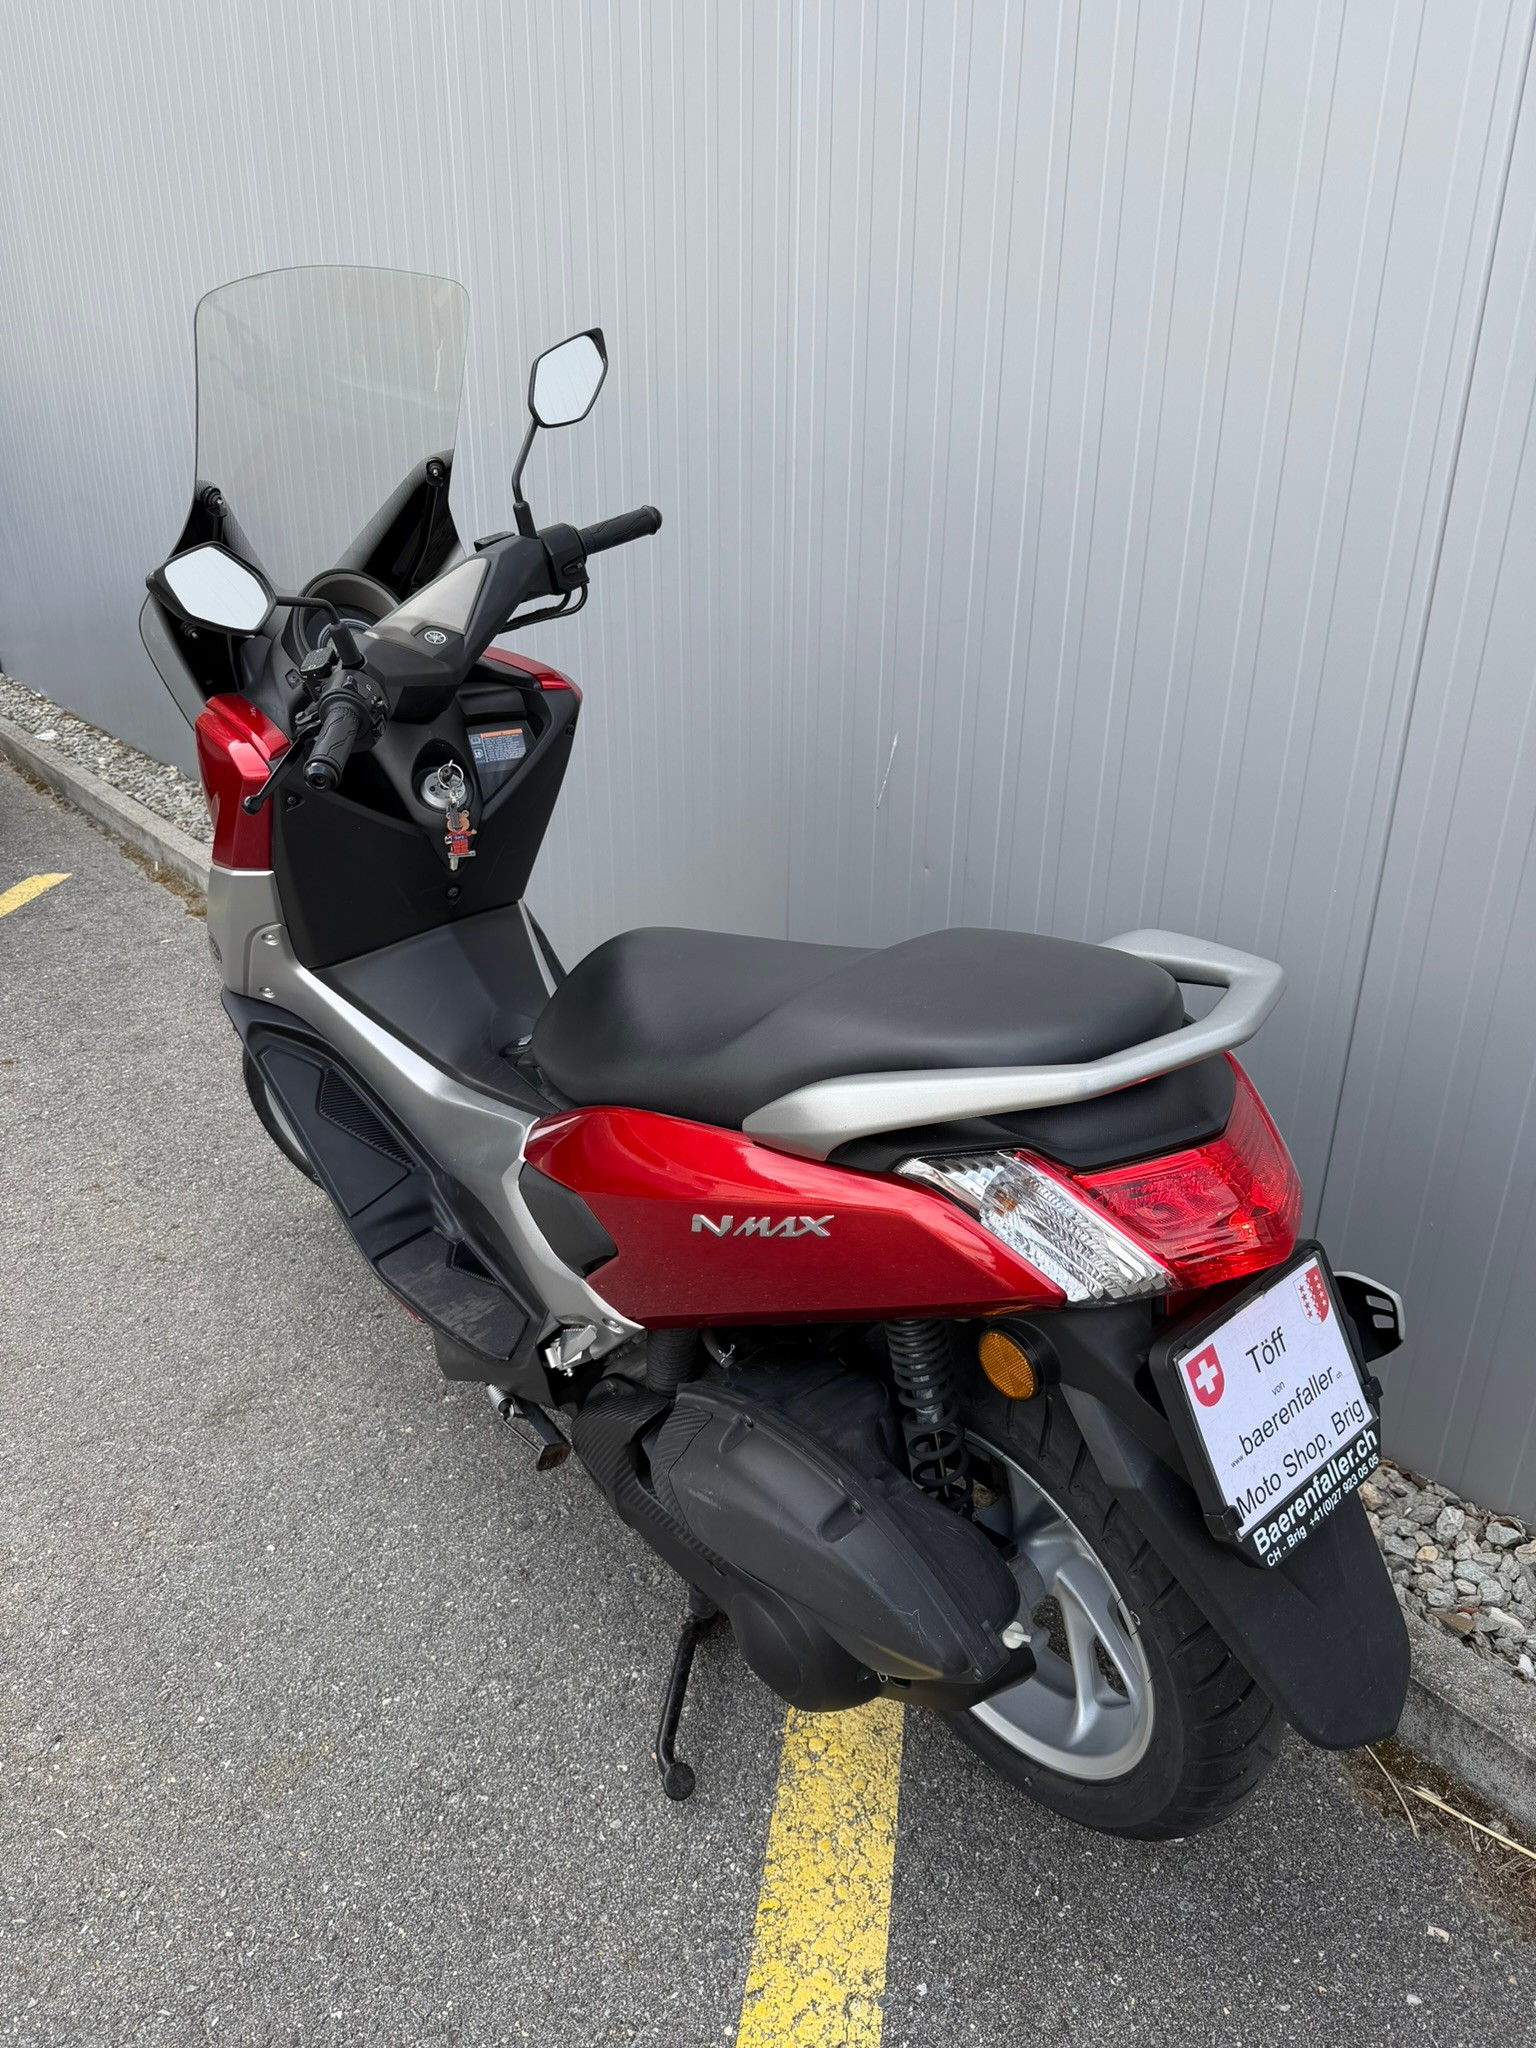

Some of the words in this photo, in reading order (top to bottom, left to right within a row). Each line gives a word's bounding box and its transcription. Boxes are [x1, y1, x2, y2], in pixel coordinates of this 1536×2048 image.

[691, 1213, 835, 1238] NMAX
[1245, 1326, 1288, 1374] Töff
[1271, 1380, 1286, 1397] von
[1236, 1472, 1282, 1519] Moto
[1283, 1433, 1334, 1478] Shop,
[1331, 1398, 1366, 1436] Brig
[1252, 1428, 1378, 1556] Baerenfaller.ch
[1266, 1547, 1283, 1567] CH
[1286, 1525, 1308, 1549] Brig
[1309, 1489, 1343, 1527] +41(0)27
[1342, 1473, 1359, 1494] 923
[1357, 1463, 1370, 1479] 05
[1367, 1452, 1380, 1469] 05
